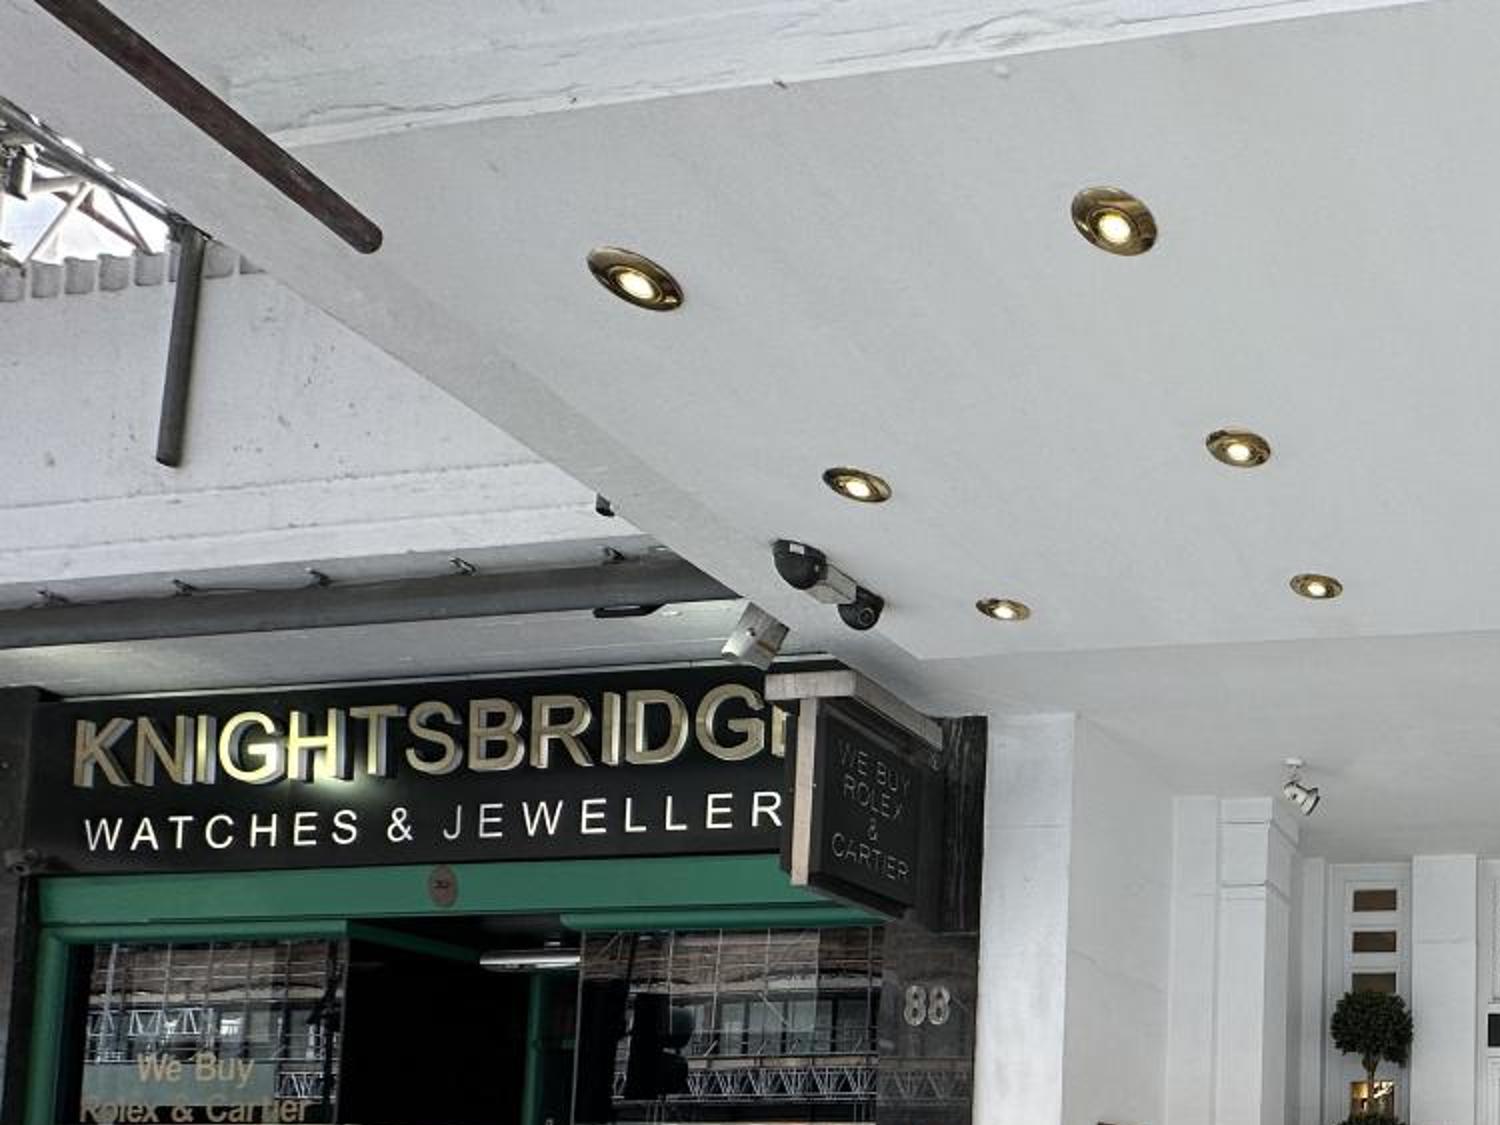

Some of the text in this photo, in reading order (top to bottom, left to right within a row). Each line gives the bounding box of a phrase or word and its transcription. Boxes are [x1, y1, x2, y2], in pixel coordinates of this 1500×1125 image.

[837, 738, 869, 777] WE
[843, 772, 905, 820] ROLEX
[85, 791, 782, 851] WATCHES & JEWELLER
[867, 817, 879, 841] &
[831, 832, 911, 885] CARTIER
[904, 985, 950, 1026] 88
[137, 1052, 255, 1088] We Buy
[79, 1095, 310, 1124] Rolex & Cartier
